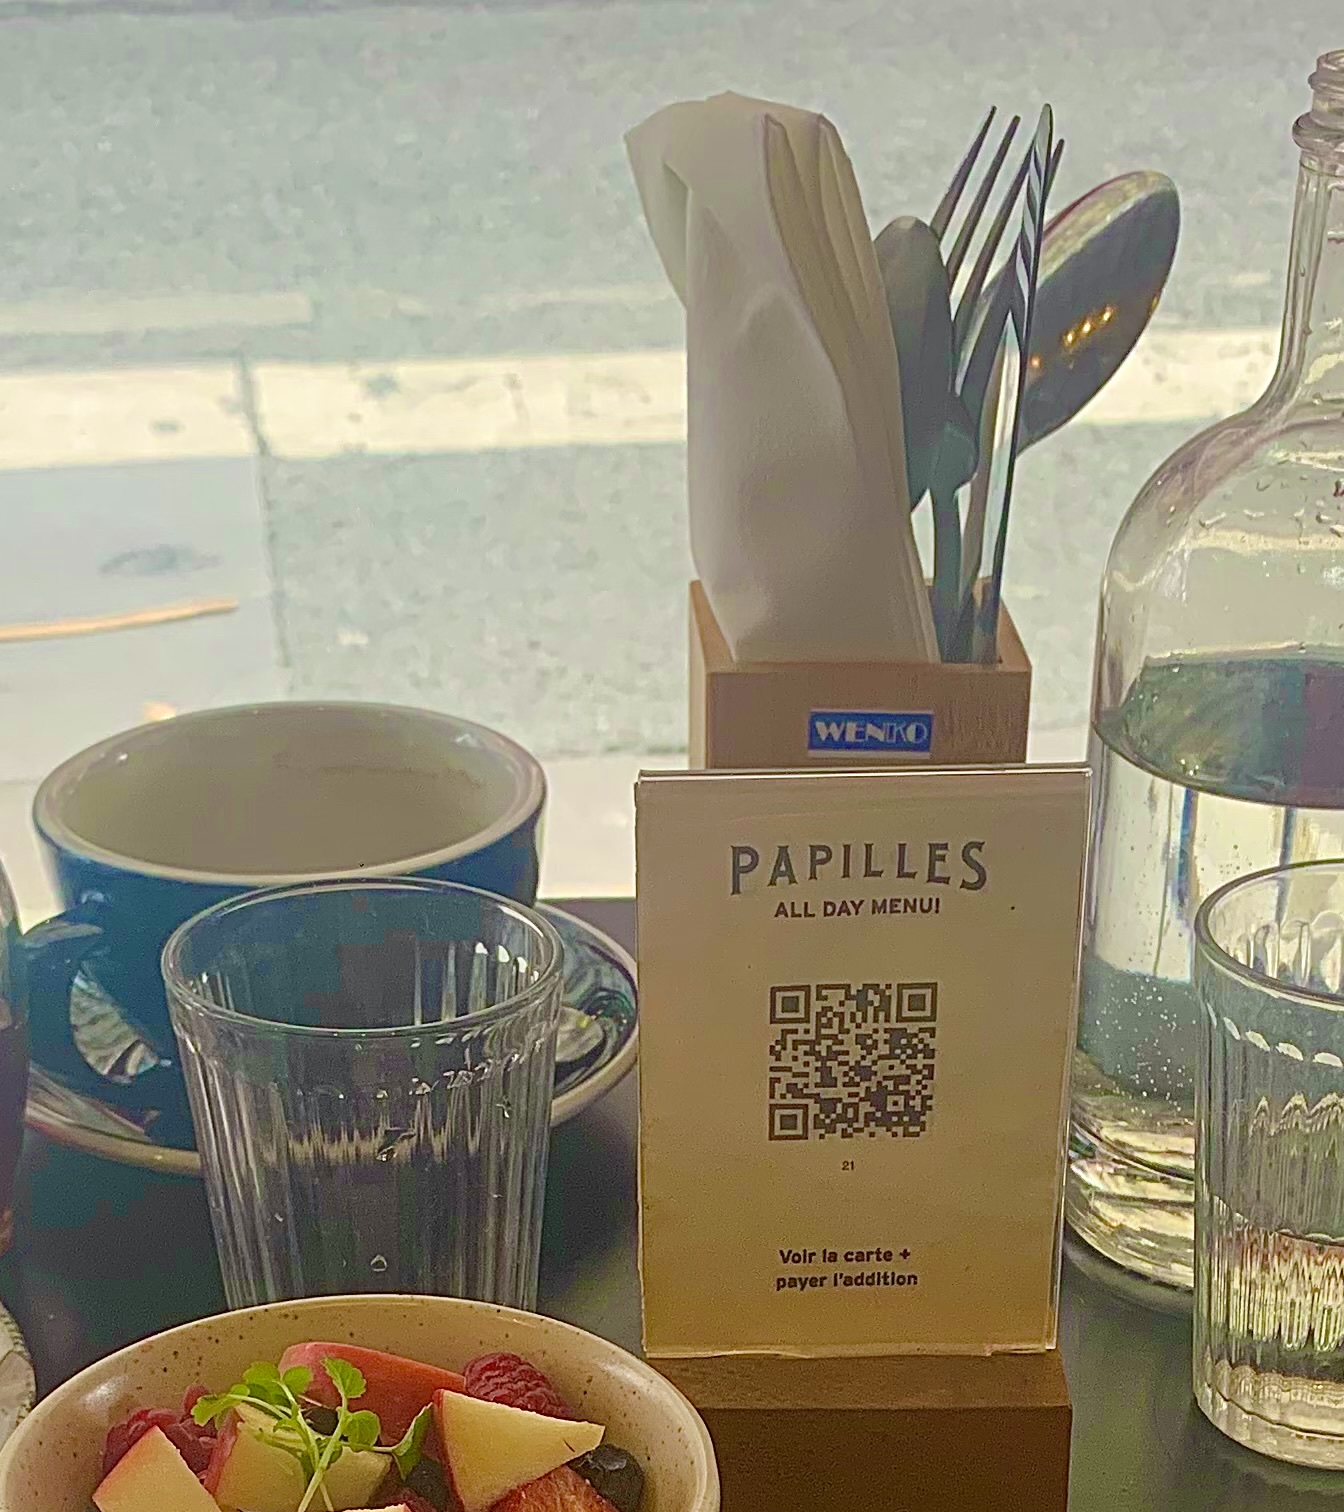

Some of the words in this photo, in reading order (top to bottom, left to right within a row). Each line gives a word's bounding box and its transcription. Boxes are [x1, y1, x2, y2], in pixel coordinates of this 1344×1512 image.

[815, 720, 928, 744] WENKO
[730, 840, 988, 896] PAPILLES
[774, 901, 816, 918] ALL
[823, 900, 865, 917] DAY
[871, 898, 941, 915] MENU!
[841, 1160, 855, 1171] 21
[779, 1249, 817, 1264] Voir
[822, 1248, 838, 1263] la
[843, 1247, 894, 1263] carte
[899, 1248, 911, 1260] +
[776, 1275, 828, 1292] payer
